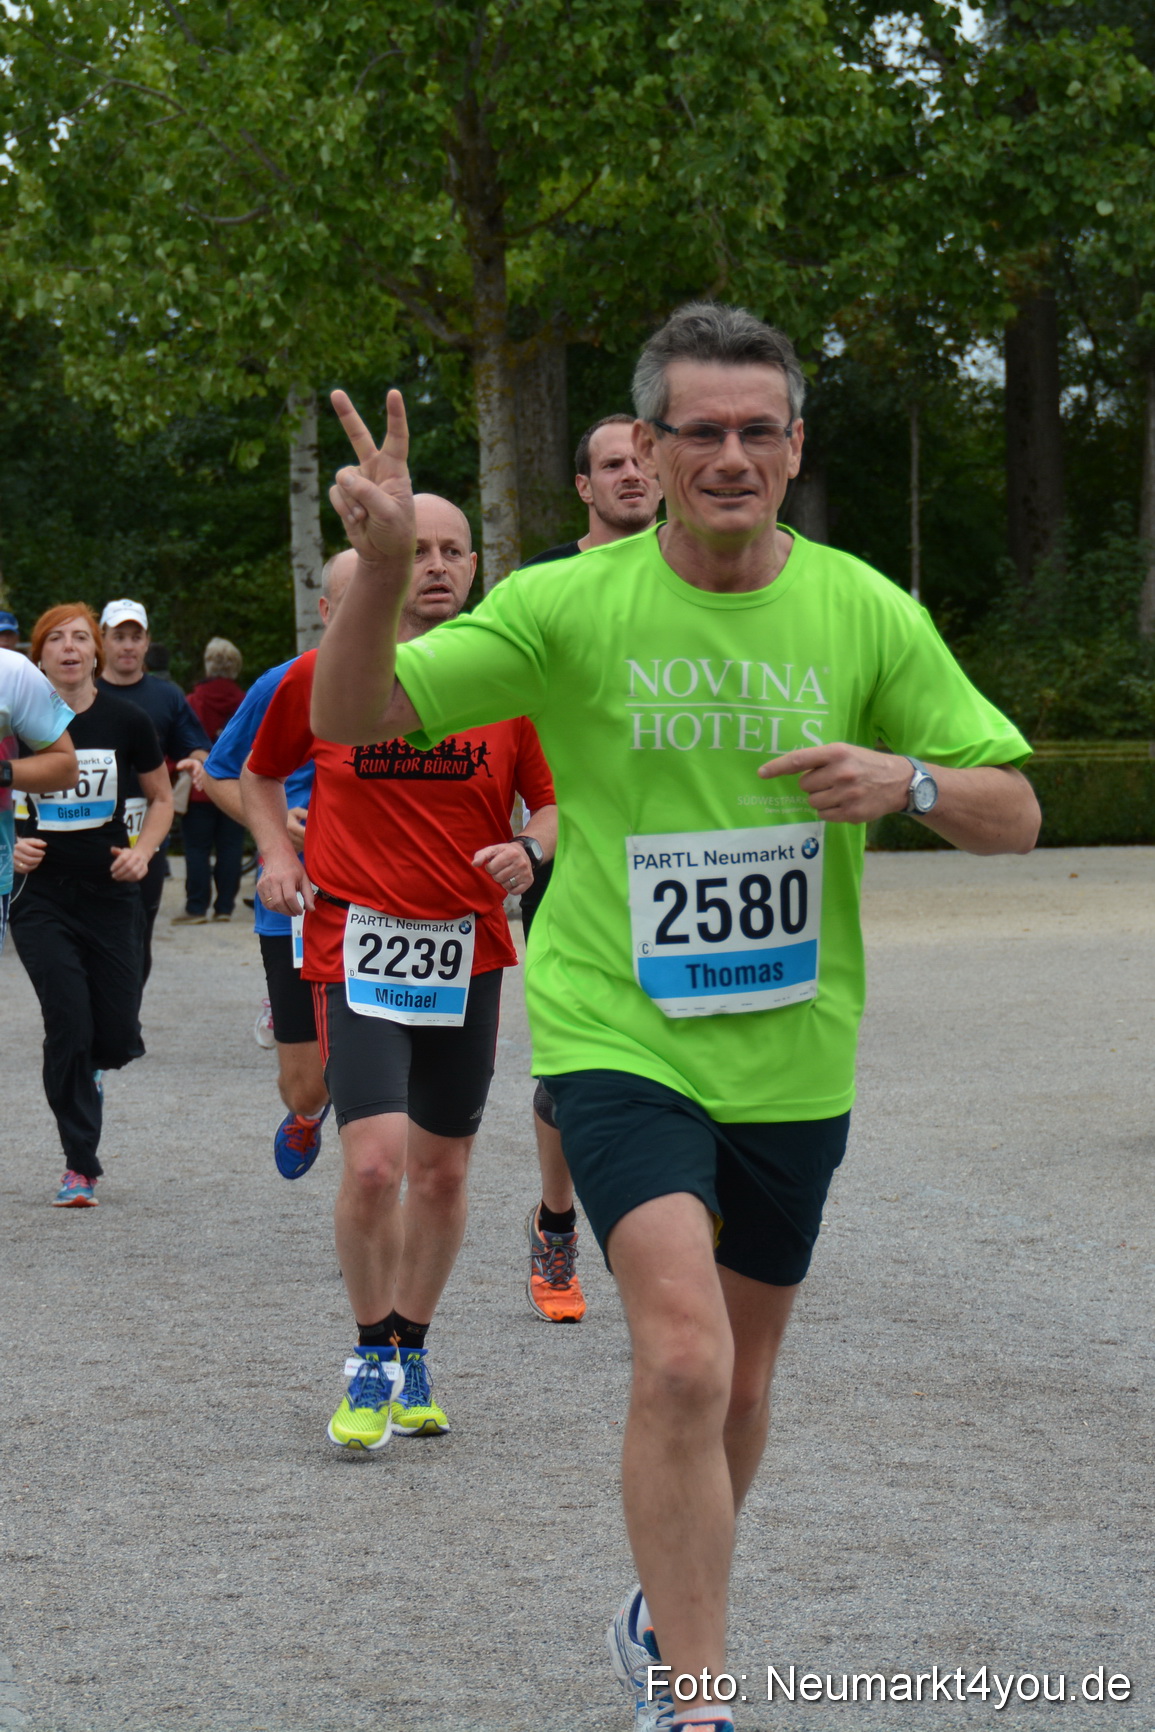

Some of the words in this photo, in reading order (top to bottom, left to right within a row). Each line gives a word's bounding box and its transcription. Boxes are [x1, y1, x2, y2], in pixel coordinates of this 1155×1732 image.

[625, 658, 828, 704] NOVINA
[630, 711, 824, 754] HOTELS
[360, 758, 389, 773] RUN
[393, 757, 420, 774] FOR
[423, 757, 469, 775] BÜRNI
[40, 769, 108, 799] 67
[57, 806, 91, 819] Gisela
[633, 852, 698, 870] PARTL
[704, 845, 795, 867] Neumarkt
[653, 869, 808, 945] 2580
[350, 914, 392, 928] PARTL
[396, 919, 454, 933] Neumarkt
[357, 933, 463, 980] 2239
[685, 961, 783, 989] Thomas
[375, 988, 437, 1008] Michael
